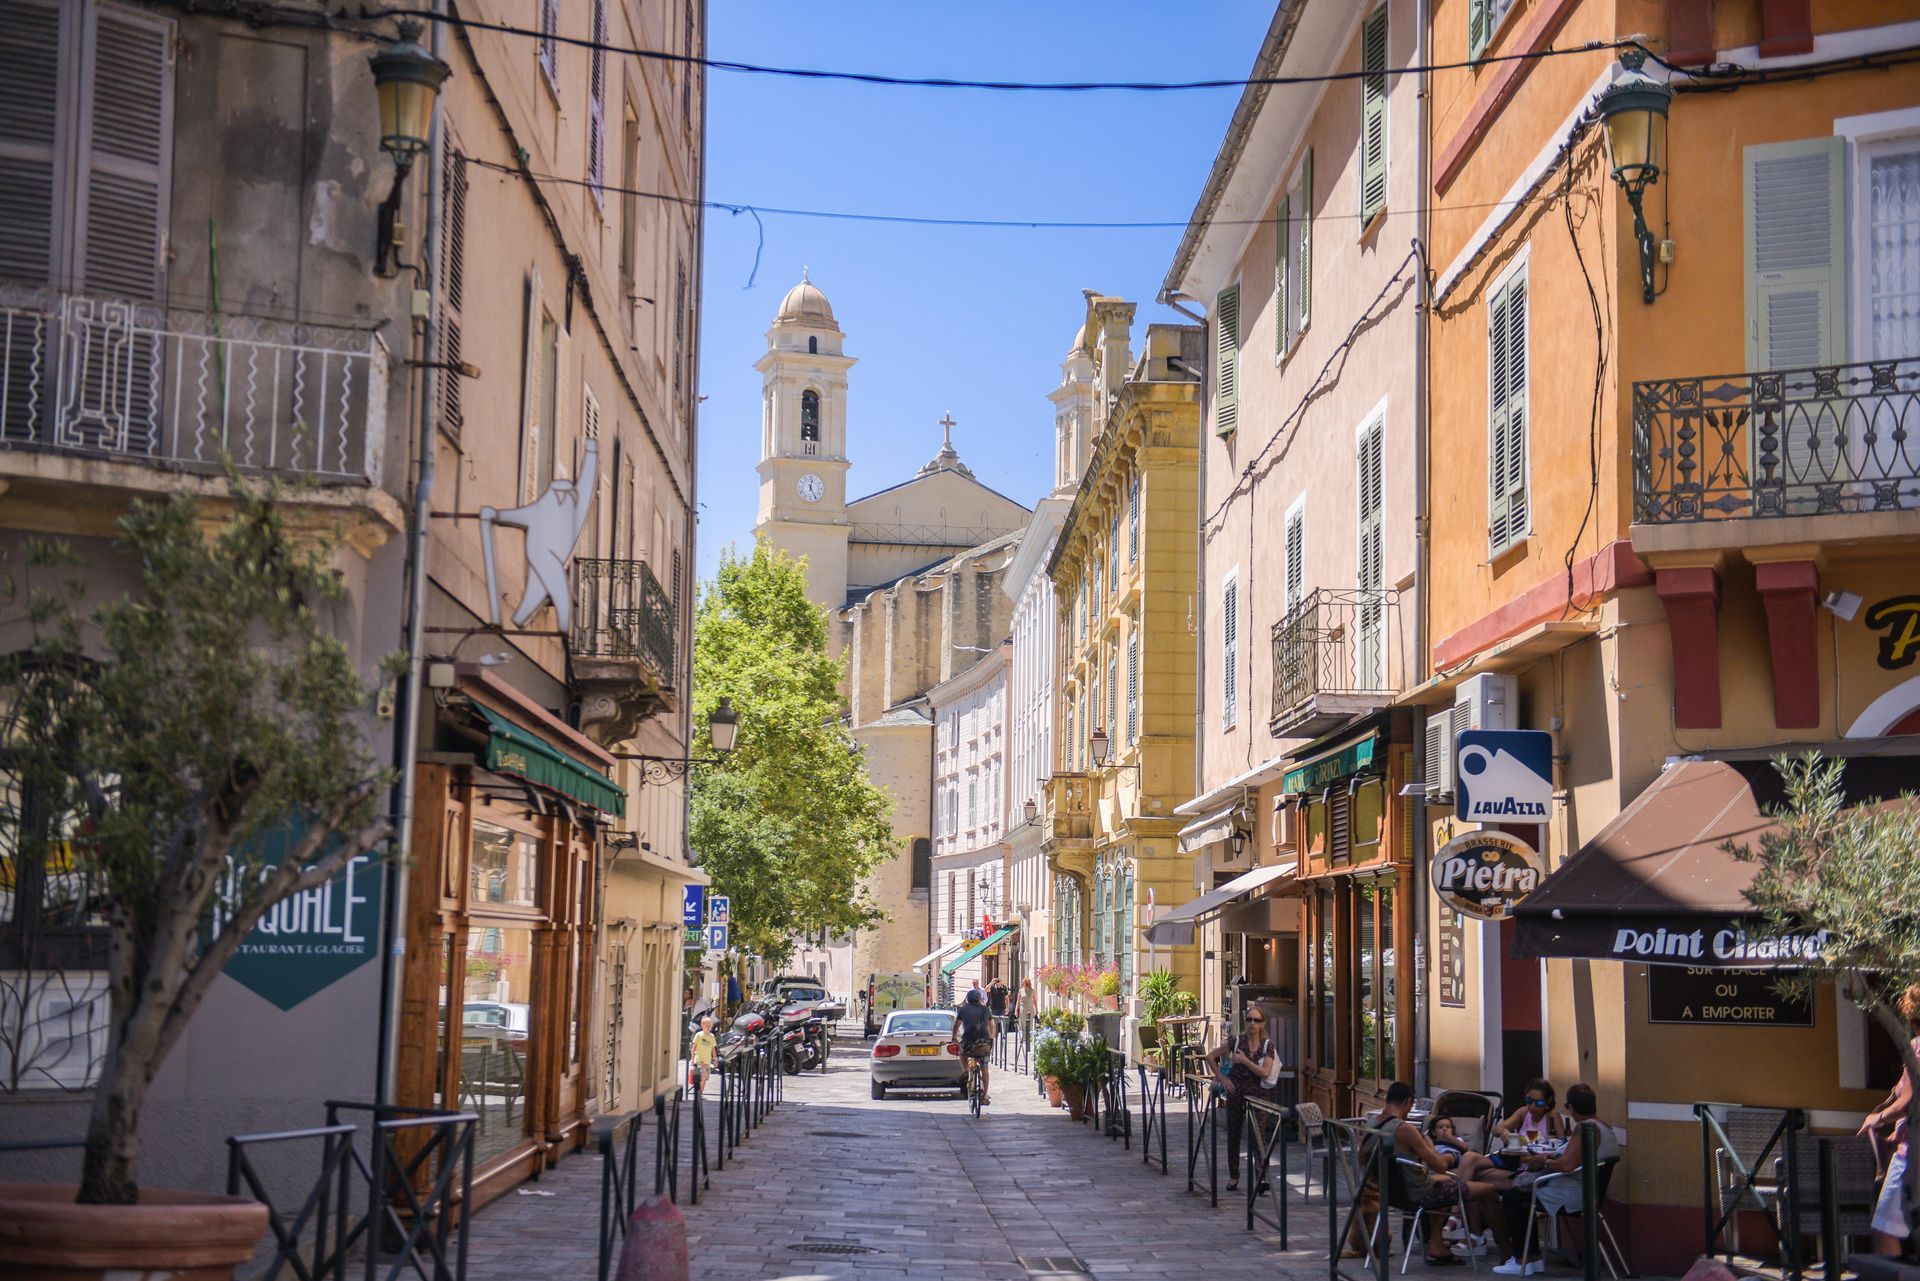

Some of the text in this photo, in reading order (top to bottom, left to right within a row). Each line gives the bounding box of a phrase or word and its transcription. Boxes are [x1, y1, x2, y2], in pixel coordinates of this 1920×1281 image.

[1474, 797, 1546, 815] LAVAZZA
[1465, 837, 1514, 849] BRASSERIE
[1441, 858, 1538, 893] Pietra
[714, 929, 722, 946] P
[1613, 928, 1703, 957] Point
[1715, 984, 1737, 998] OU
[1682, 1006, 1775, 1020] A EMPORTER
